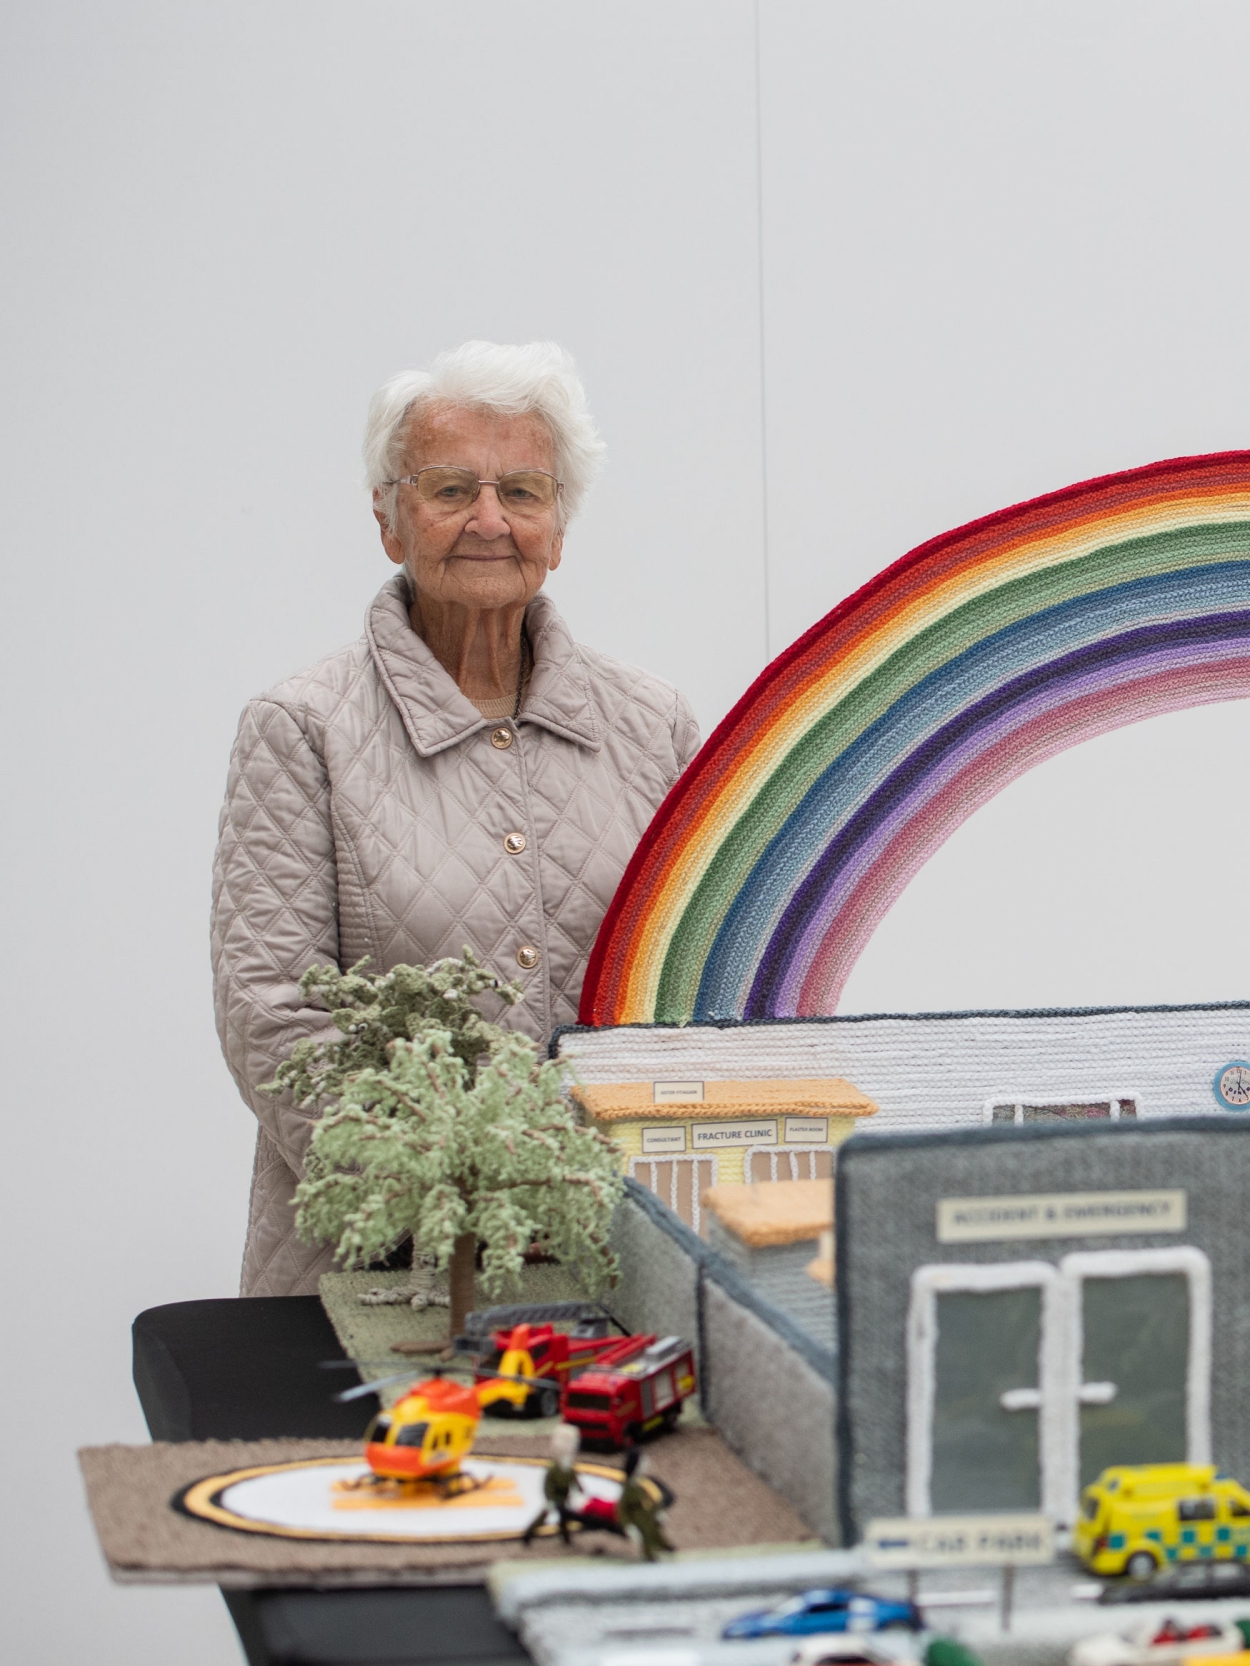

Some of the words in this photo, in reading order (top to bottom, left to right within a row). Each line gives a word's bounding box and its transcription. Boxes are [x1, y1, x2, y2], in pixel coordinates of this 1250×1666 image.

[697, 1131, 743, 1141] FRACTURE
[744, 1129, 773, 1138] CLINIC
[953, 1203, 1039, 1227] ACCIDENT
[1062, 1200, 1172, 1221] EMERGENCY
[917, 1530, 966, 1552] CAR
